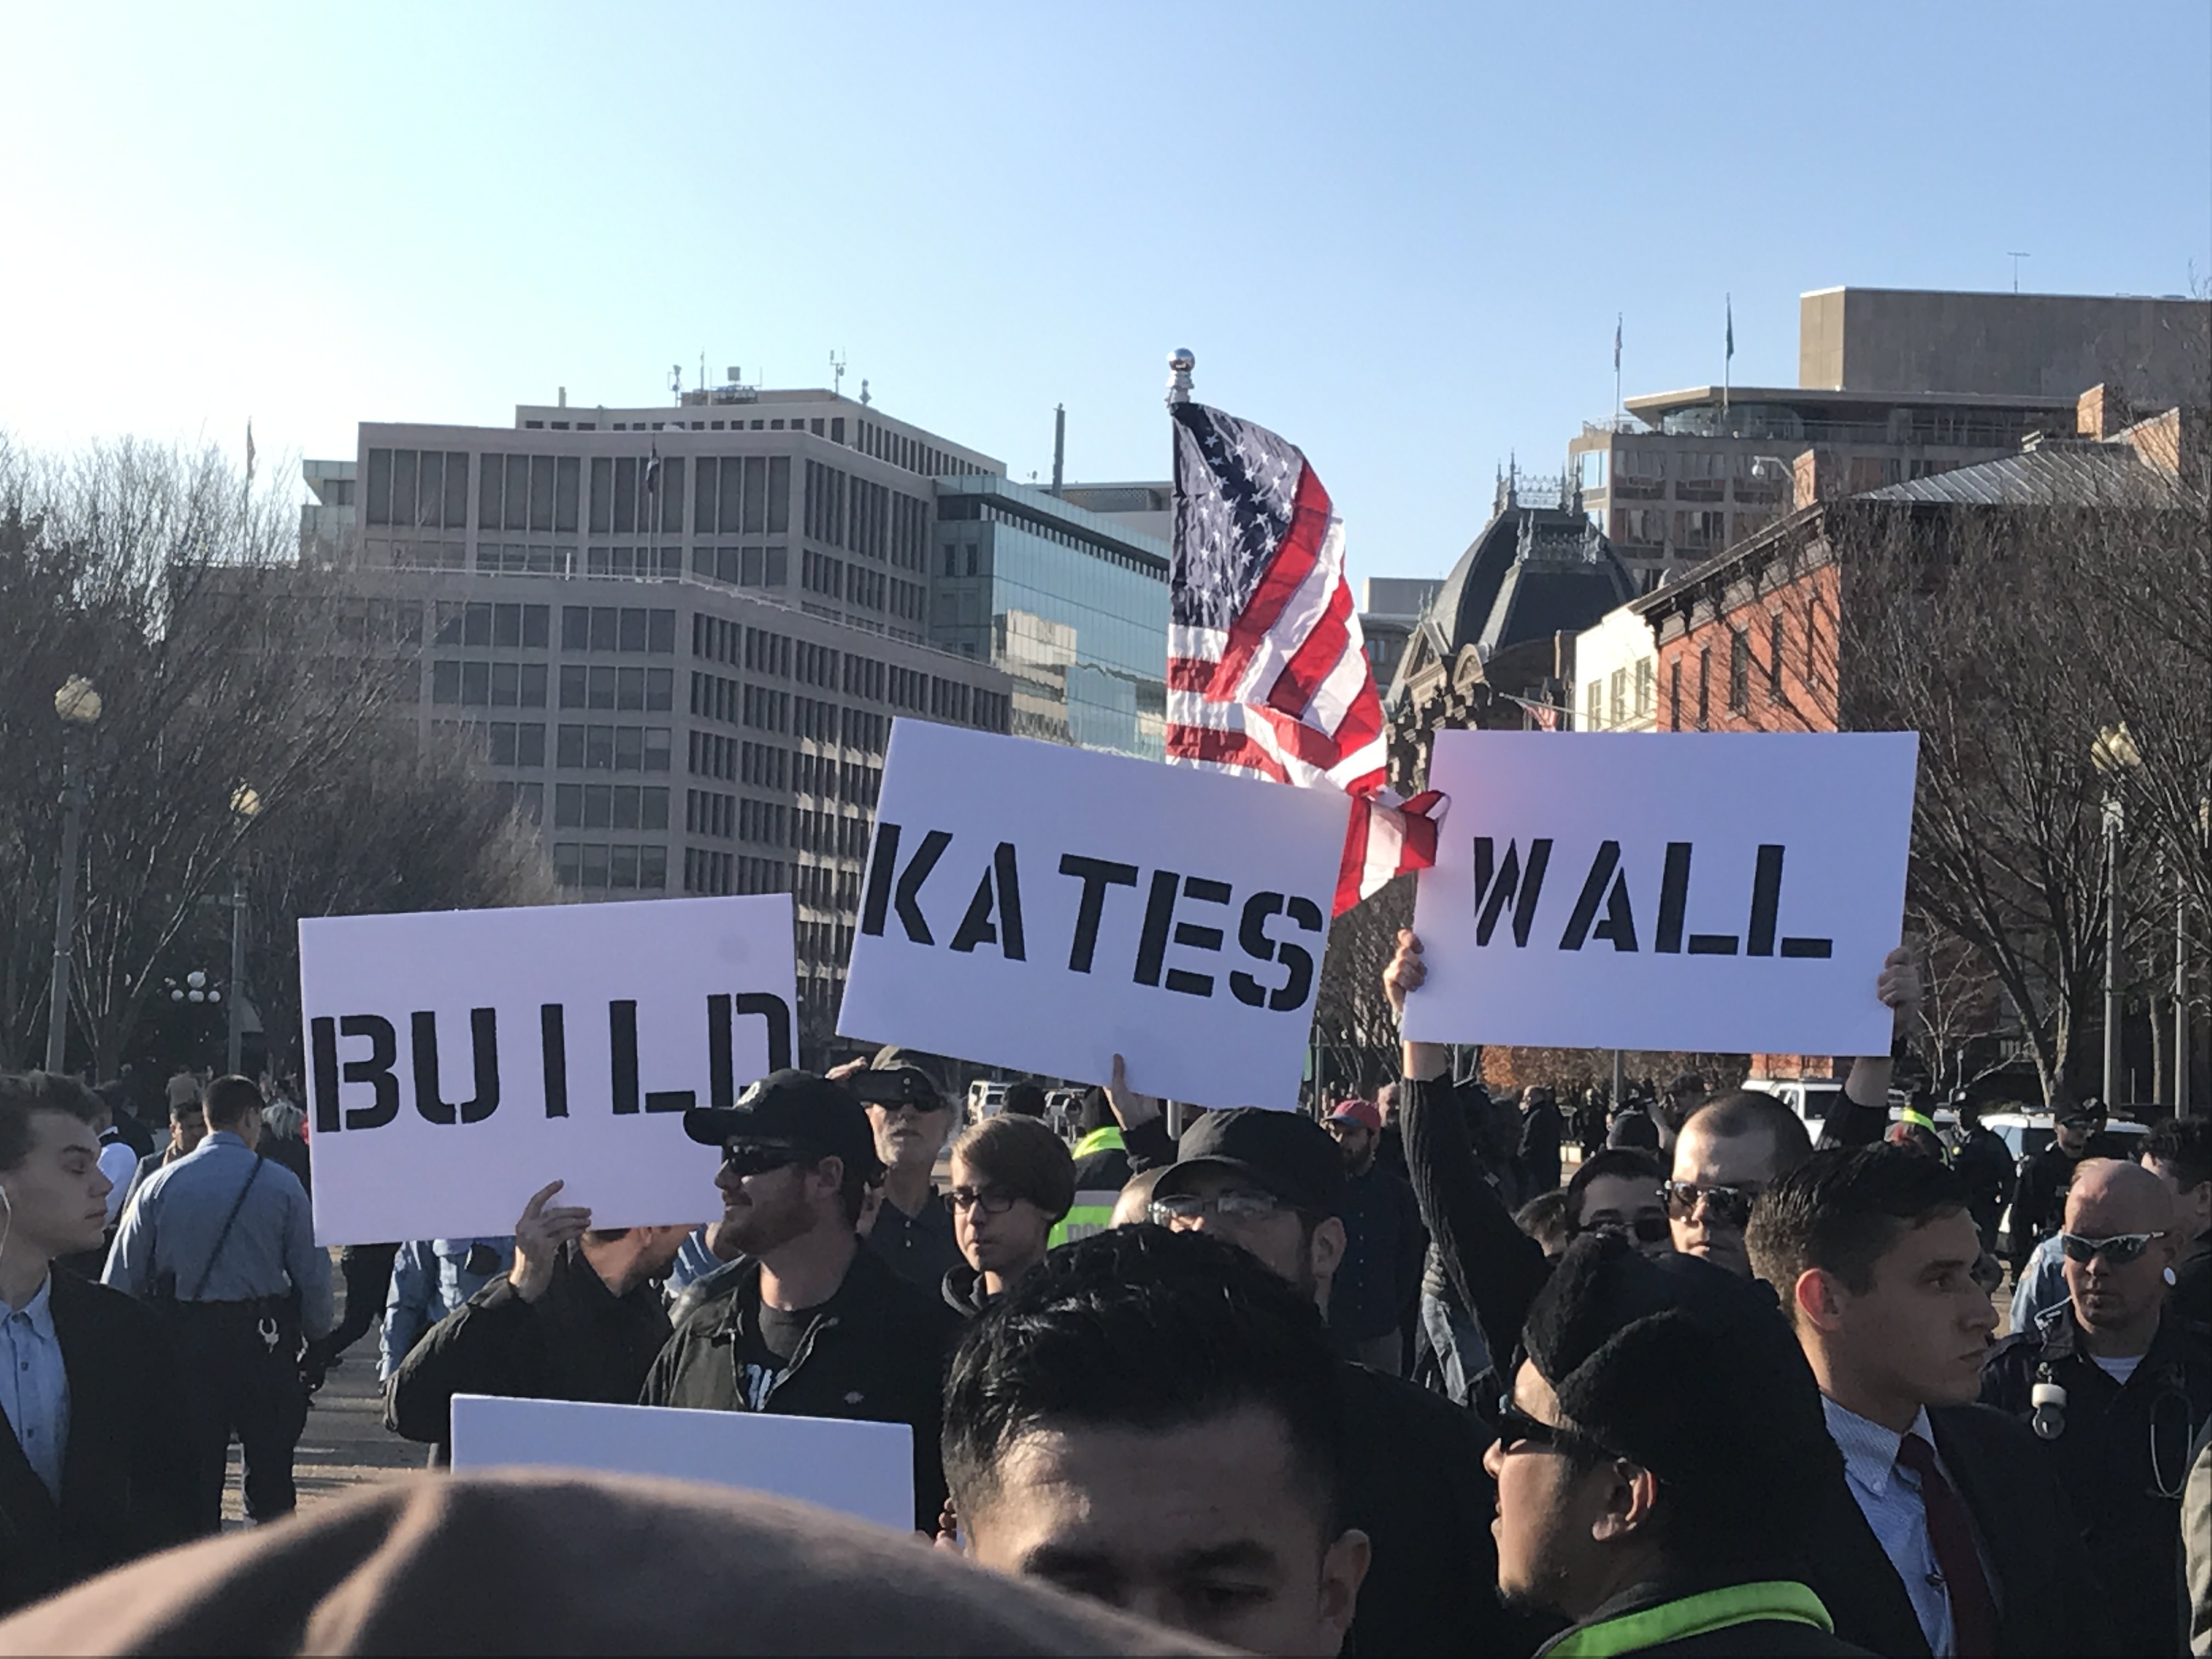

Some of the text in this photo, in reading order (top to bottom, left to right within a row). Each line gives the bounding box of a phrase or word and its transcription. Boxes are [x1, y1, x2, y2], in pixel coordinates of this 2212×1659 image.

[861, 822, 1323, 1012] KATES
[1474, 837, 1833, 959] WALL
[311, 992, 792, 1133] BUILD
